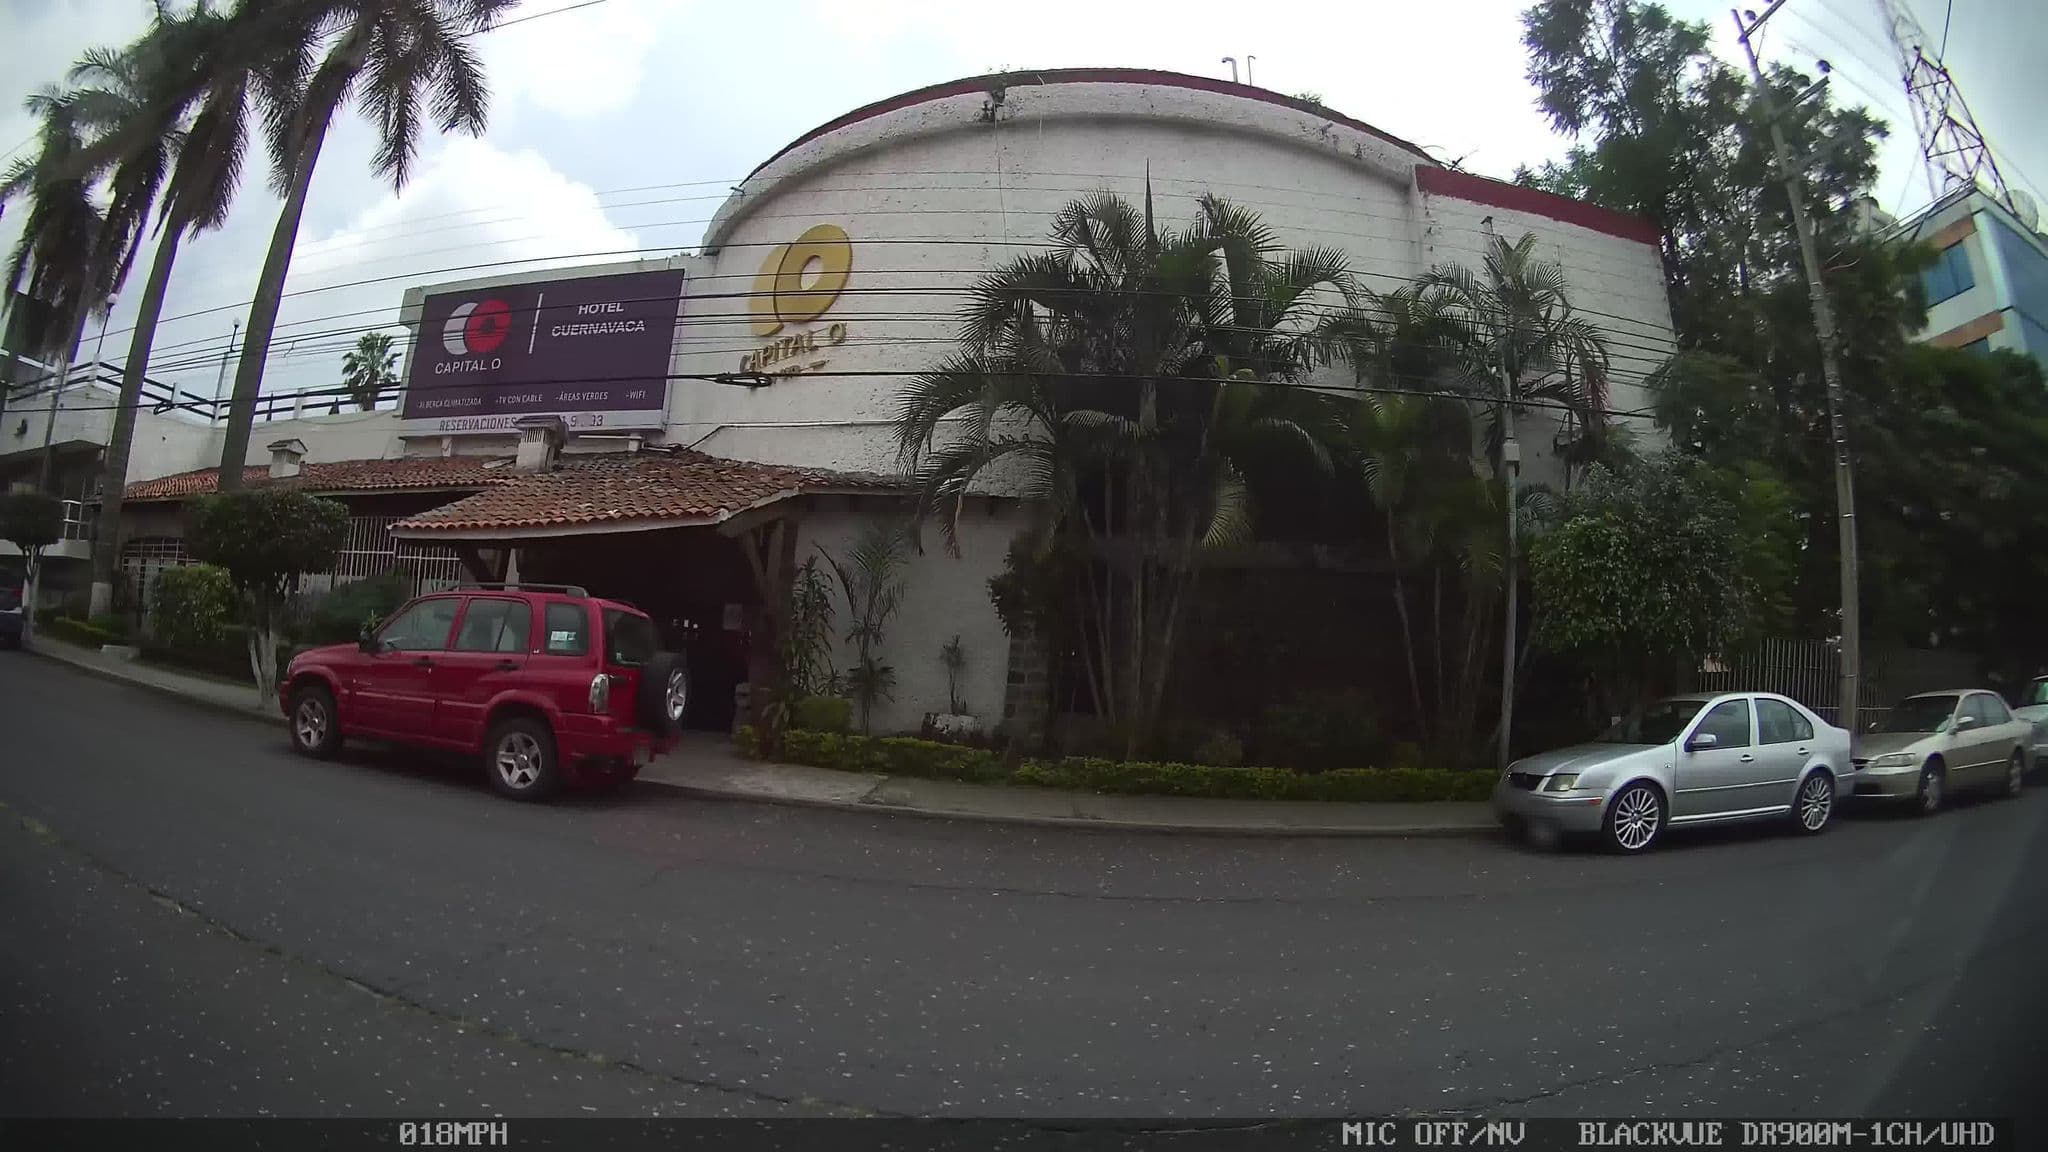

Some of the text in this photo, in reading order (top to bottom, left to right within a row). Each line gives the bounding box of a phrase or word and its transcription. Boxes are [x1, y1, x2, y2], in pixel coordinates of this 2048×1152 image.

[578, 302, 624, 315] HOTEL
[551, 320, 646, 337] CUERNAVACA
[740, 330, 819, 373] CAPITAL
[828, 322, 848, 345] O
[434, 358, 501, 375] CAPITAL O
[507, 395, 522, 404] CON
[522, 393, 543, 403] CABLE
[581, 391, 609, 400] VERDES
[440, 417, 517, 431] RESERVACIONES
